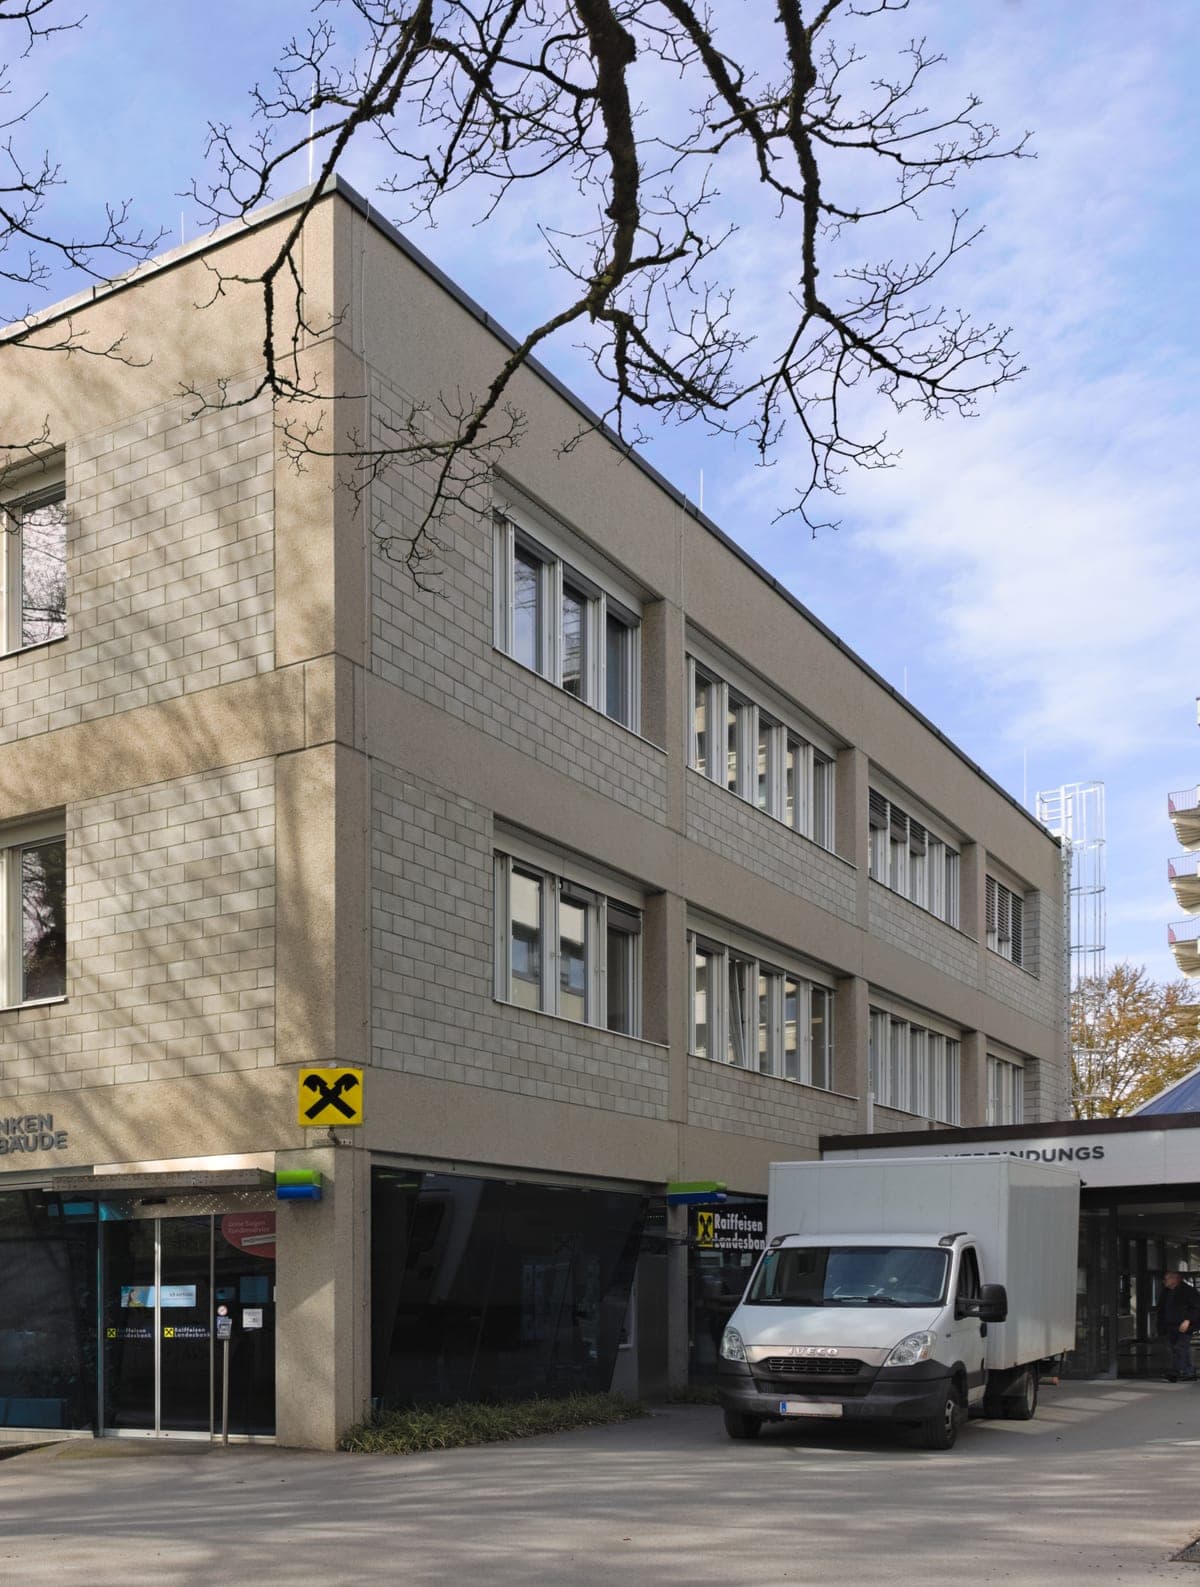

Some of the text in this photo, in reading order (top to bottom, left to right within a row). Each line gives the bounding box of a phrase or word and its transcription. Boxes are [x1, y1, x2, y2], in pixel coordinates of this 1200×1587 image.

[714, 1212, 763, 1232] Raiffeisen
[714, 1232, 766, 1250] Landesban
[788, 1346, 839, 1357] IVECO
